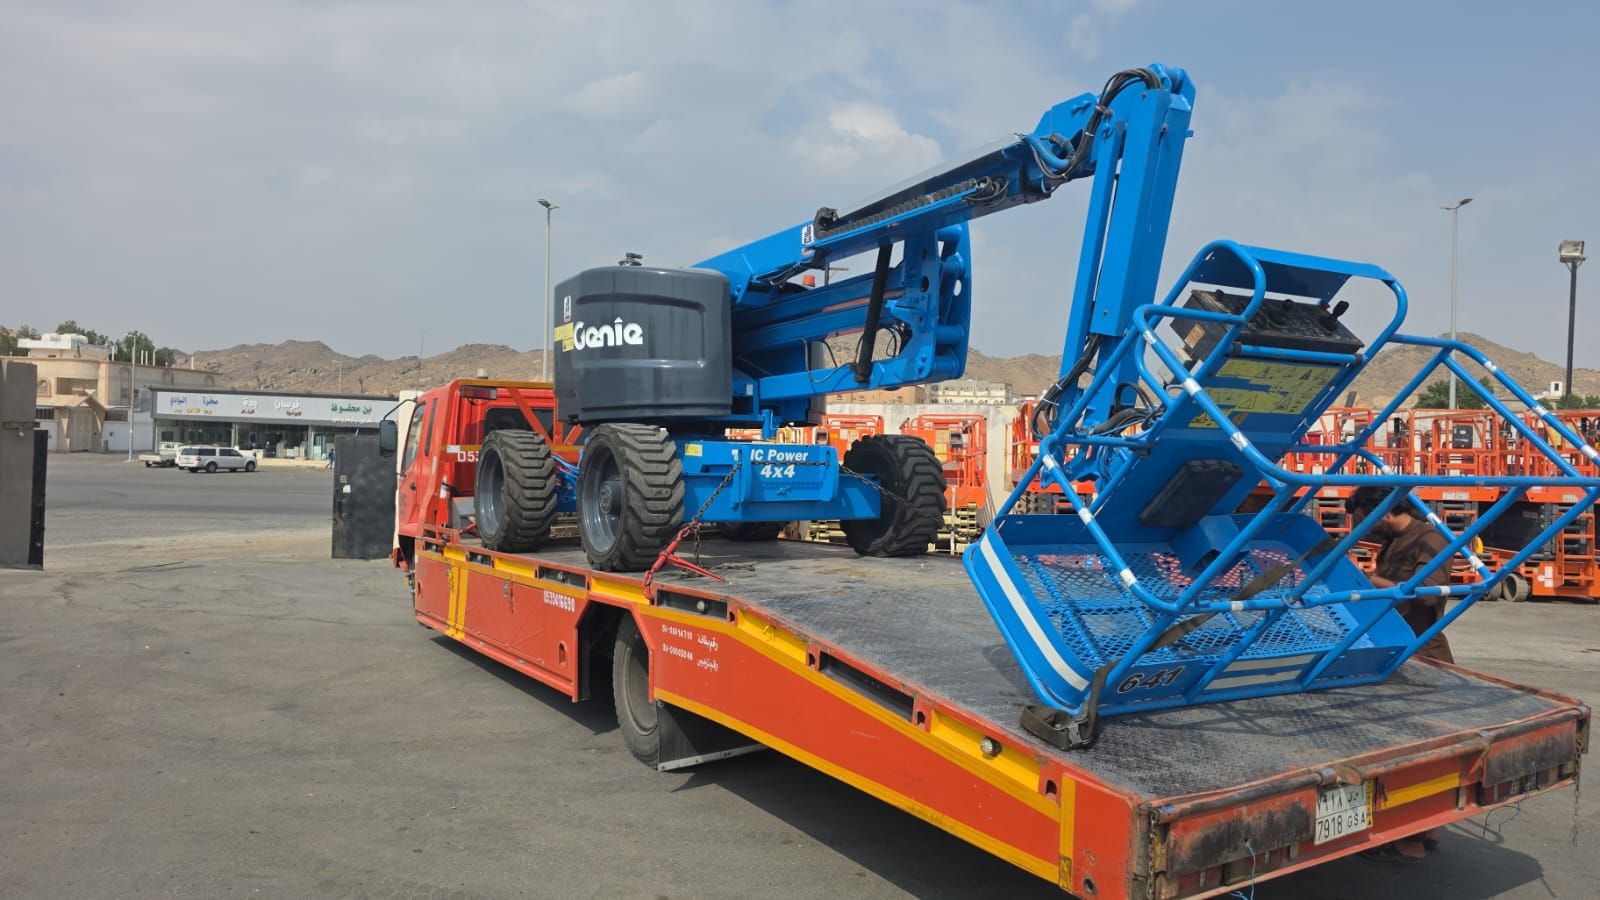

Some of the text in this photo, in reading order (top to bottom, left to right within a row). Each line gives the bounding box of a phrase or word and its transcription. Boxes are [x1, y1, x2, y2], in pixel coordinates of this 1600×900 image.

[574, 317, 643, 350] Genie
[750, 449, 809, 461] IC Power
[760, 464, 795, 478] 4x4
[1117, 665, 1186, 693] 641
[1317, 815, 1343, 841] 7918
